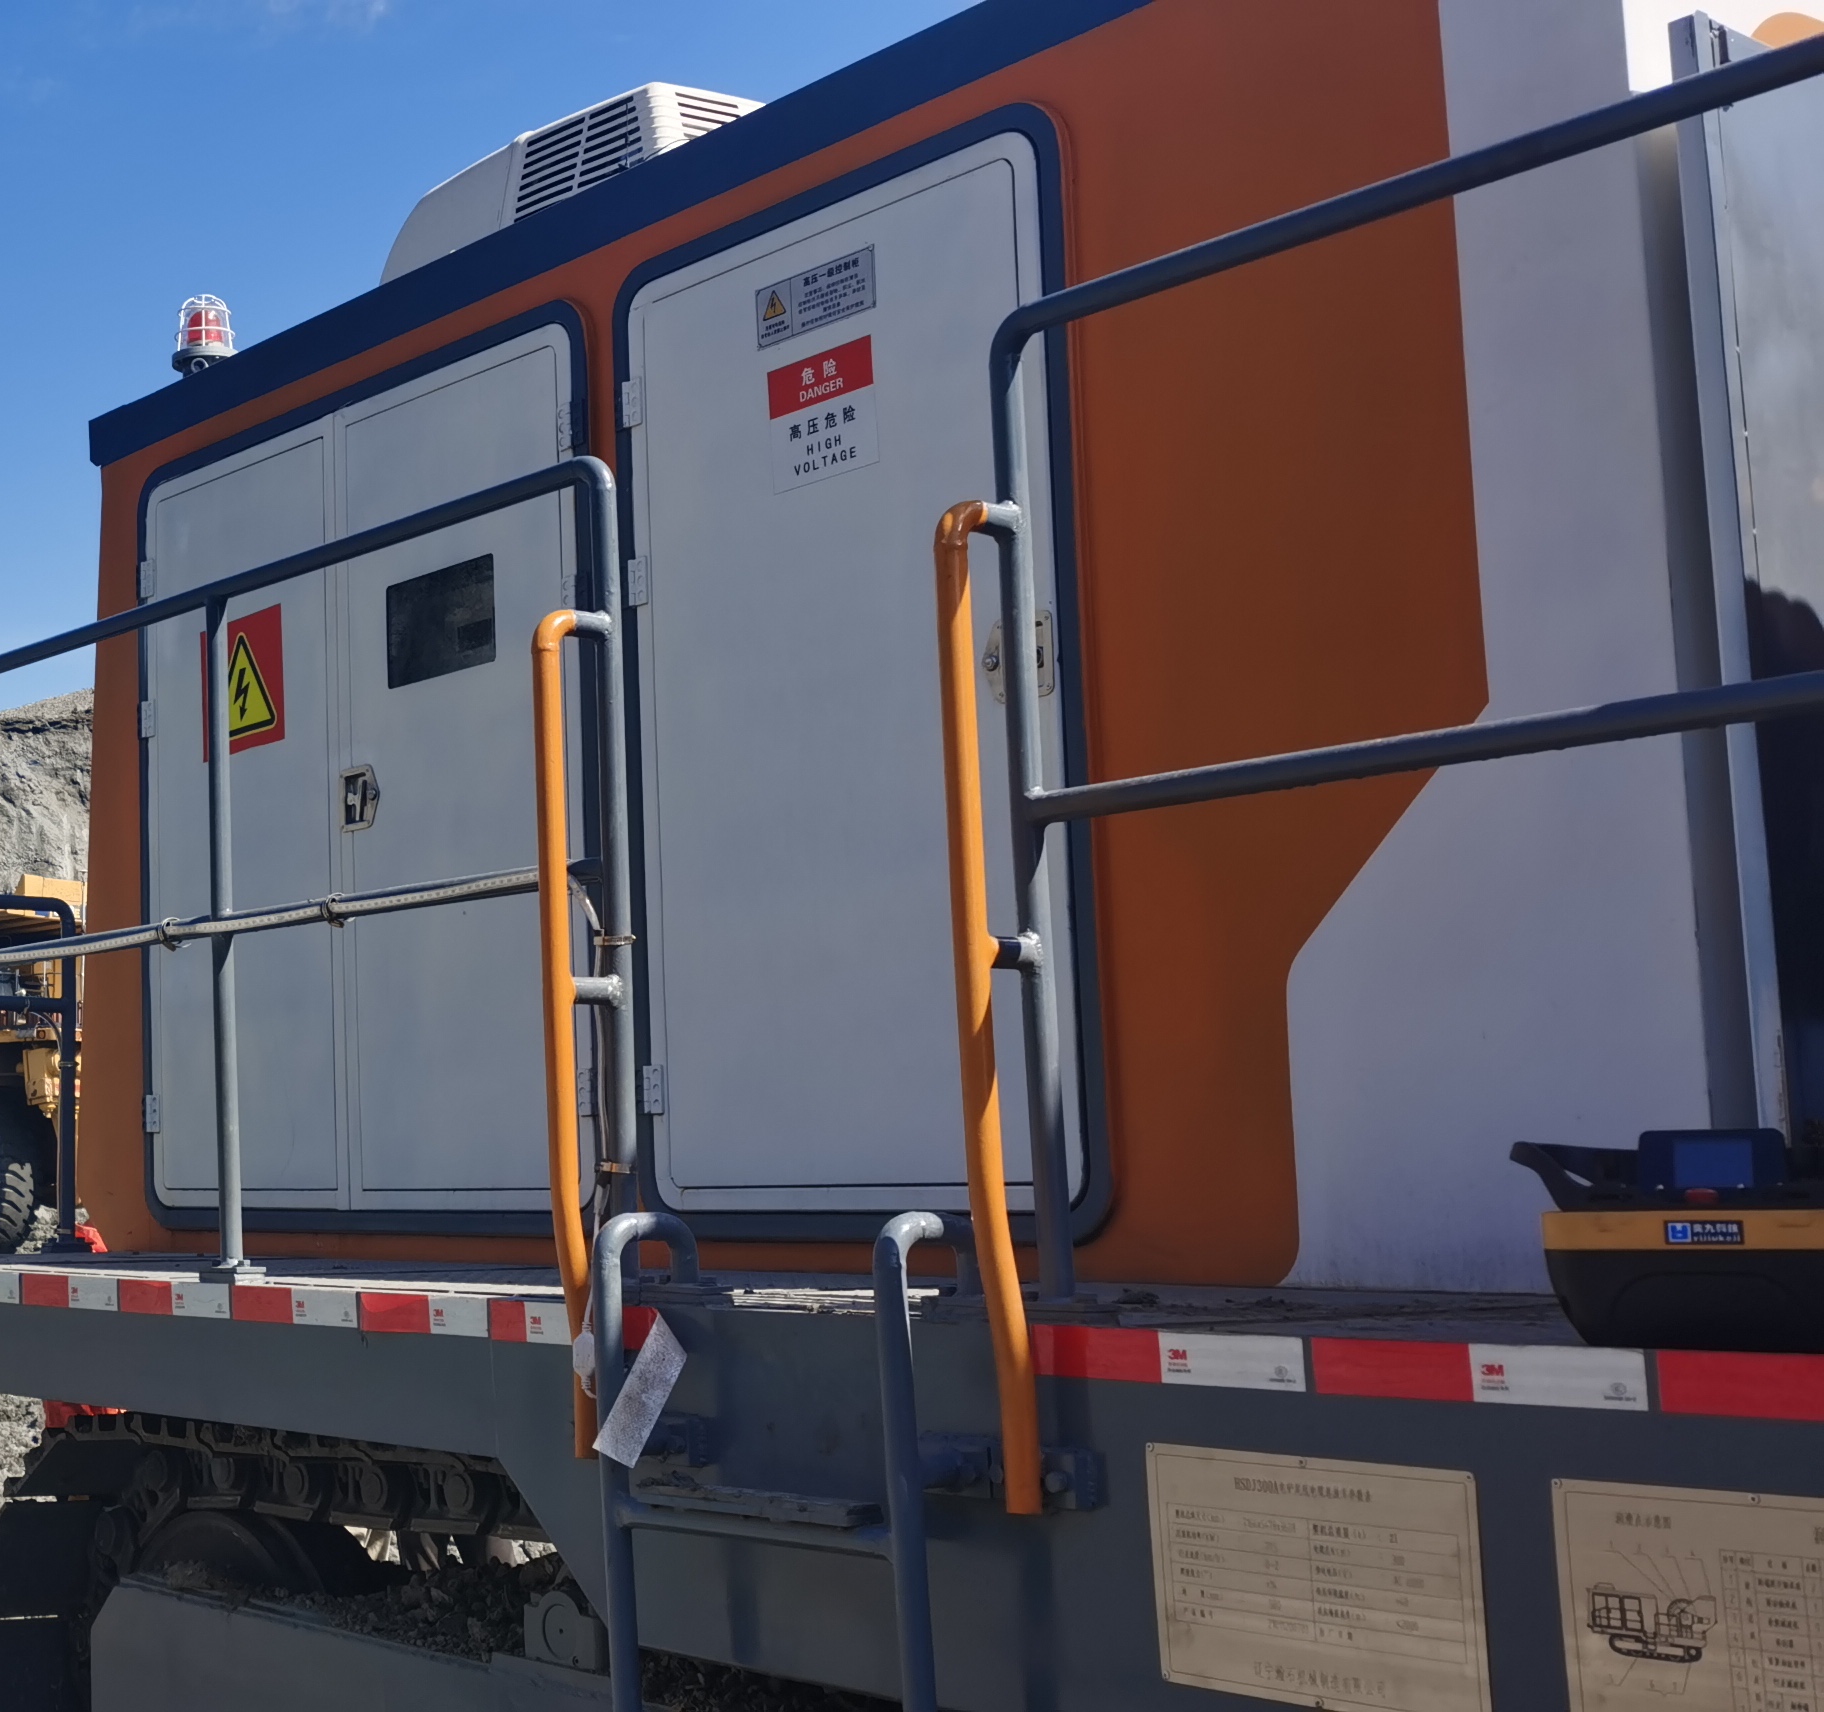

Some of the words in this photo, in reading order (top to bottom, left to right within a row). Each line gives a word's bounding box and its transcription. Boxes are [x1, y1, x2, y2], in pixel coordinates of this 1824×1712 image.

[801, 358, 838, 386] 危险
[799, 378, 844, 402] DANGER
[789, 405, 856, 442] 高压危险
[806, 434, 842, 456] HIGH
[794, 446, 857, 476] VOLTAGE
[434, 1309, 444, 1317] 3M
[530, 1317, 542, 1326] 3M
[1169, 1349, 1187, 1361] 3M
[1483, 1364, 1504, 1377] 3M
